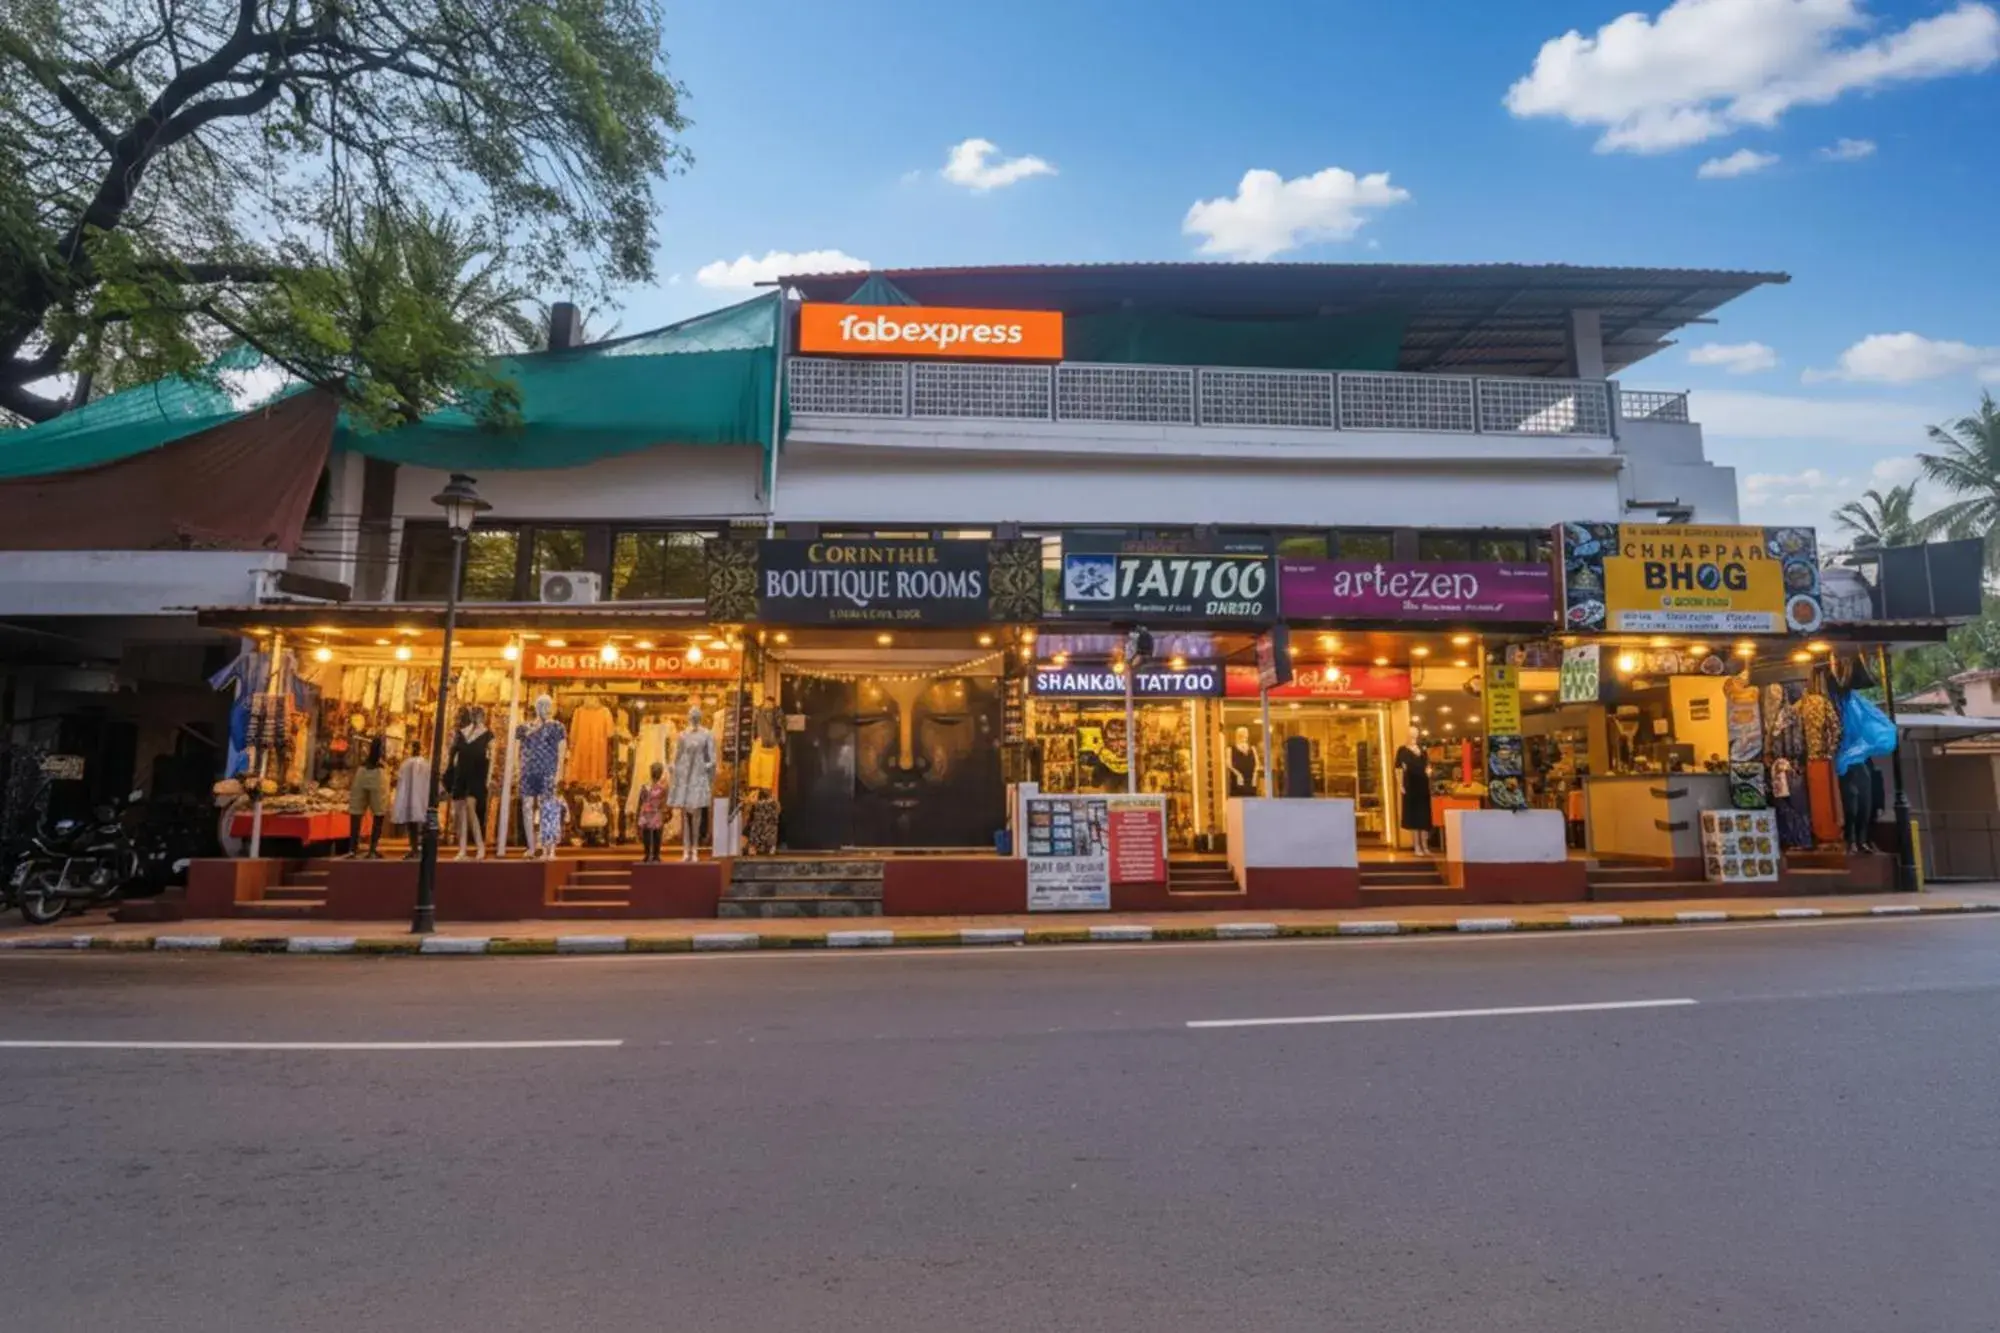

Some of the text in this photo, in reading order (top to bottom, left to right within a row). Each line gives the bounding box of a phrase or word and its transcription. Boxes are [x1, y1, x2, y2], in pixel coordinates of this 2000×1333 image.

[838, 314, 1022, 349] fabexpress
[766, 569, 982, 607] BOUTIQUE ROOMS
[1119, 559, 1267, 599] TATTOO
[1333, 563, 1479, 600] artezen
[1644, 561, 1748, 591] BHOG
